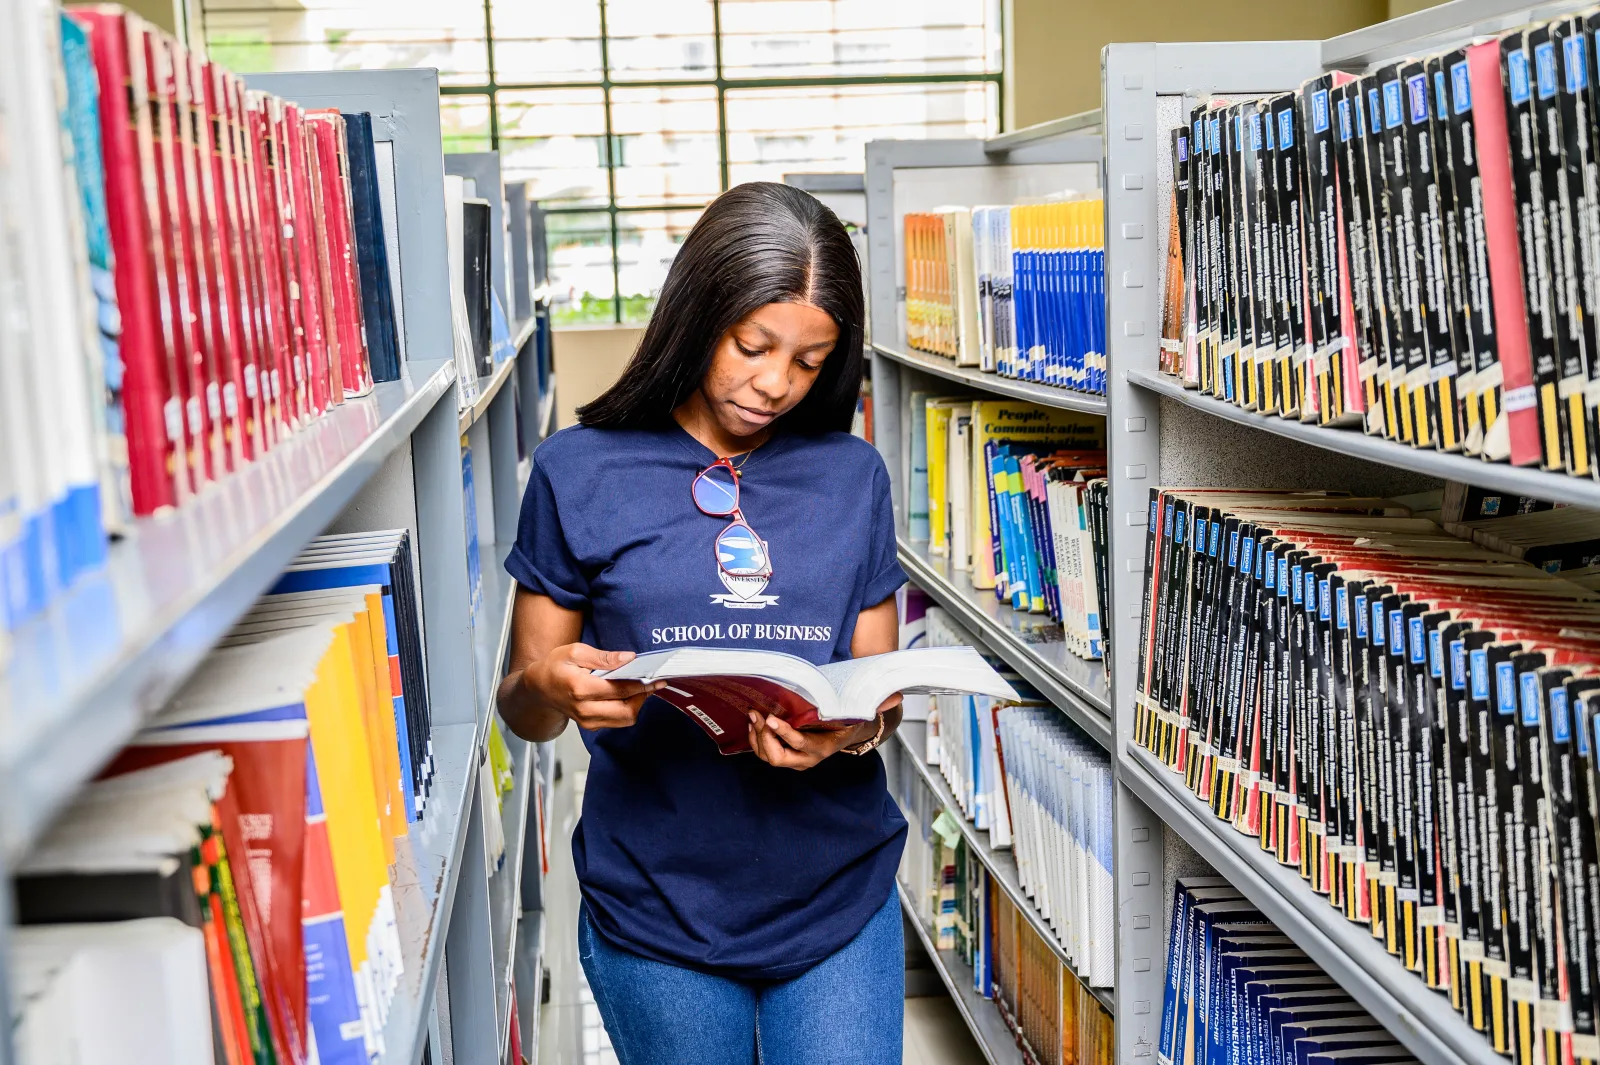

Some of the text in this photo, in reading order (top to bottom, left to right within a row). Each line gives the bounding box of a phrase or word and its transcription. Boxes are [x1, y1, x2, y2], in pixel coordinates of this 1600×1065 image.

[998, 409, 1050, 422] People,
[1058, 534, 1066, 573] RESEARCH
[1064, 536, 1072, 576] RESEARCH
[1071, 538, 1079, 578] RESEARCH
[651, 624, 831, 644] SCHOOL OF BUSINESS
[1238, 625, 1246, 651] Effective
[1234, 670, 1242, 698] Business
[1231, 698, 1239, 737] Management
[1171, 892, 1185, 990] ENTREPRENEURSHIP
[1183, 906, 1195, 1005] ENTREPRENEURSHIP
[1250, 1007, 1258, 1058] PERSPECTIVES
